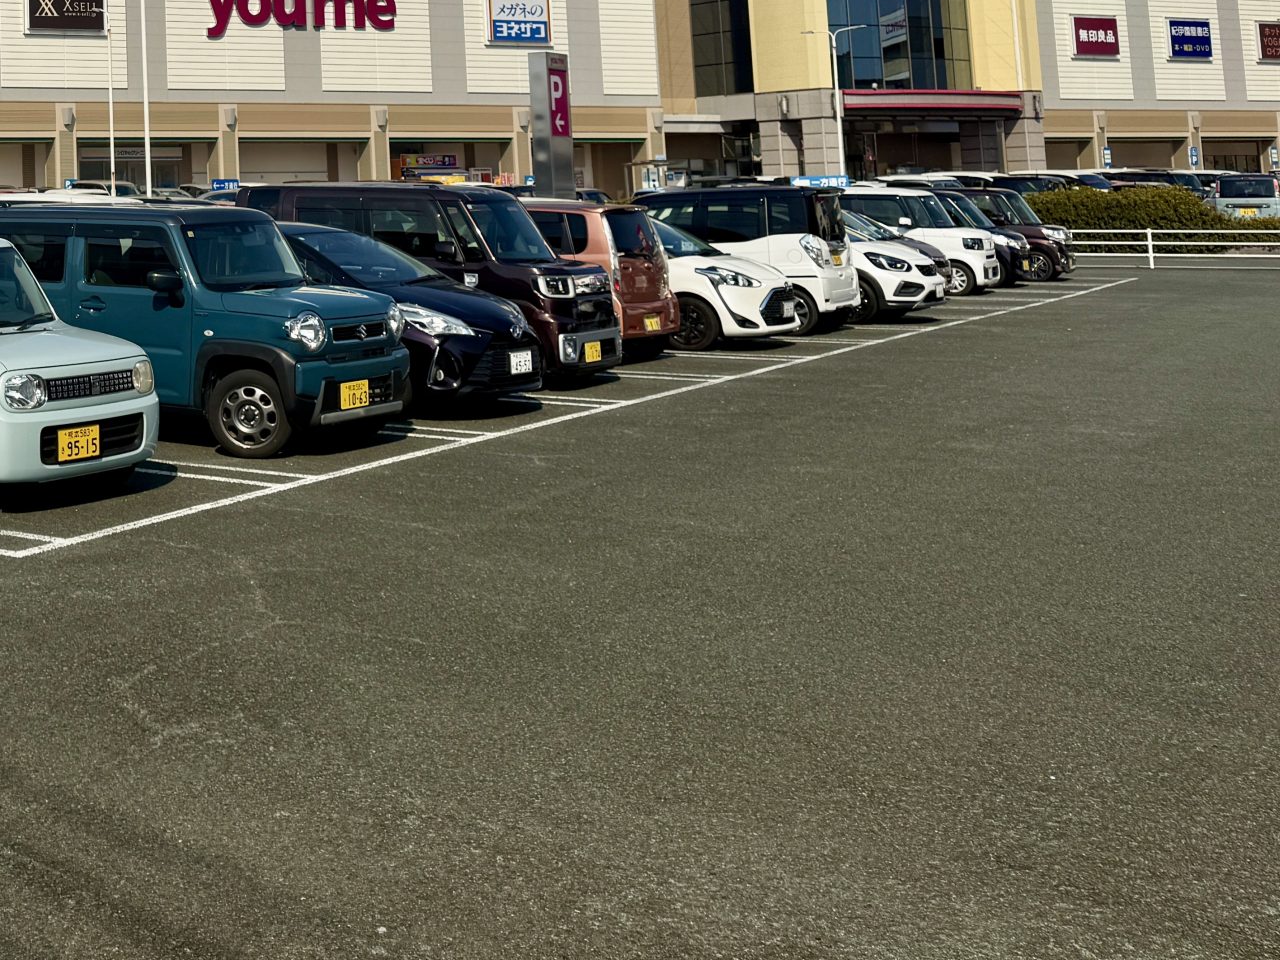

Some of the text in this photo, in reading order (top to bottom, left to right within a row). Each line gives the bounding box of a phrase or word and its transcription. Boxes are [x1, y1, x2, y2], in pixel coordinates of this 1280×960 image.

[496, 3, 544, 18] メガネの
[495, 21, 546, 38] ヨネザワ
[1079, 29, 1116, 44] 無印良品
[550, 75, 563, 111] P
[67, 437, 98, 458] 95-15
